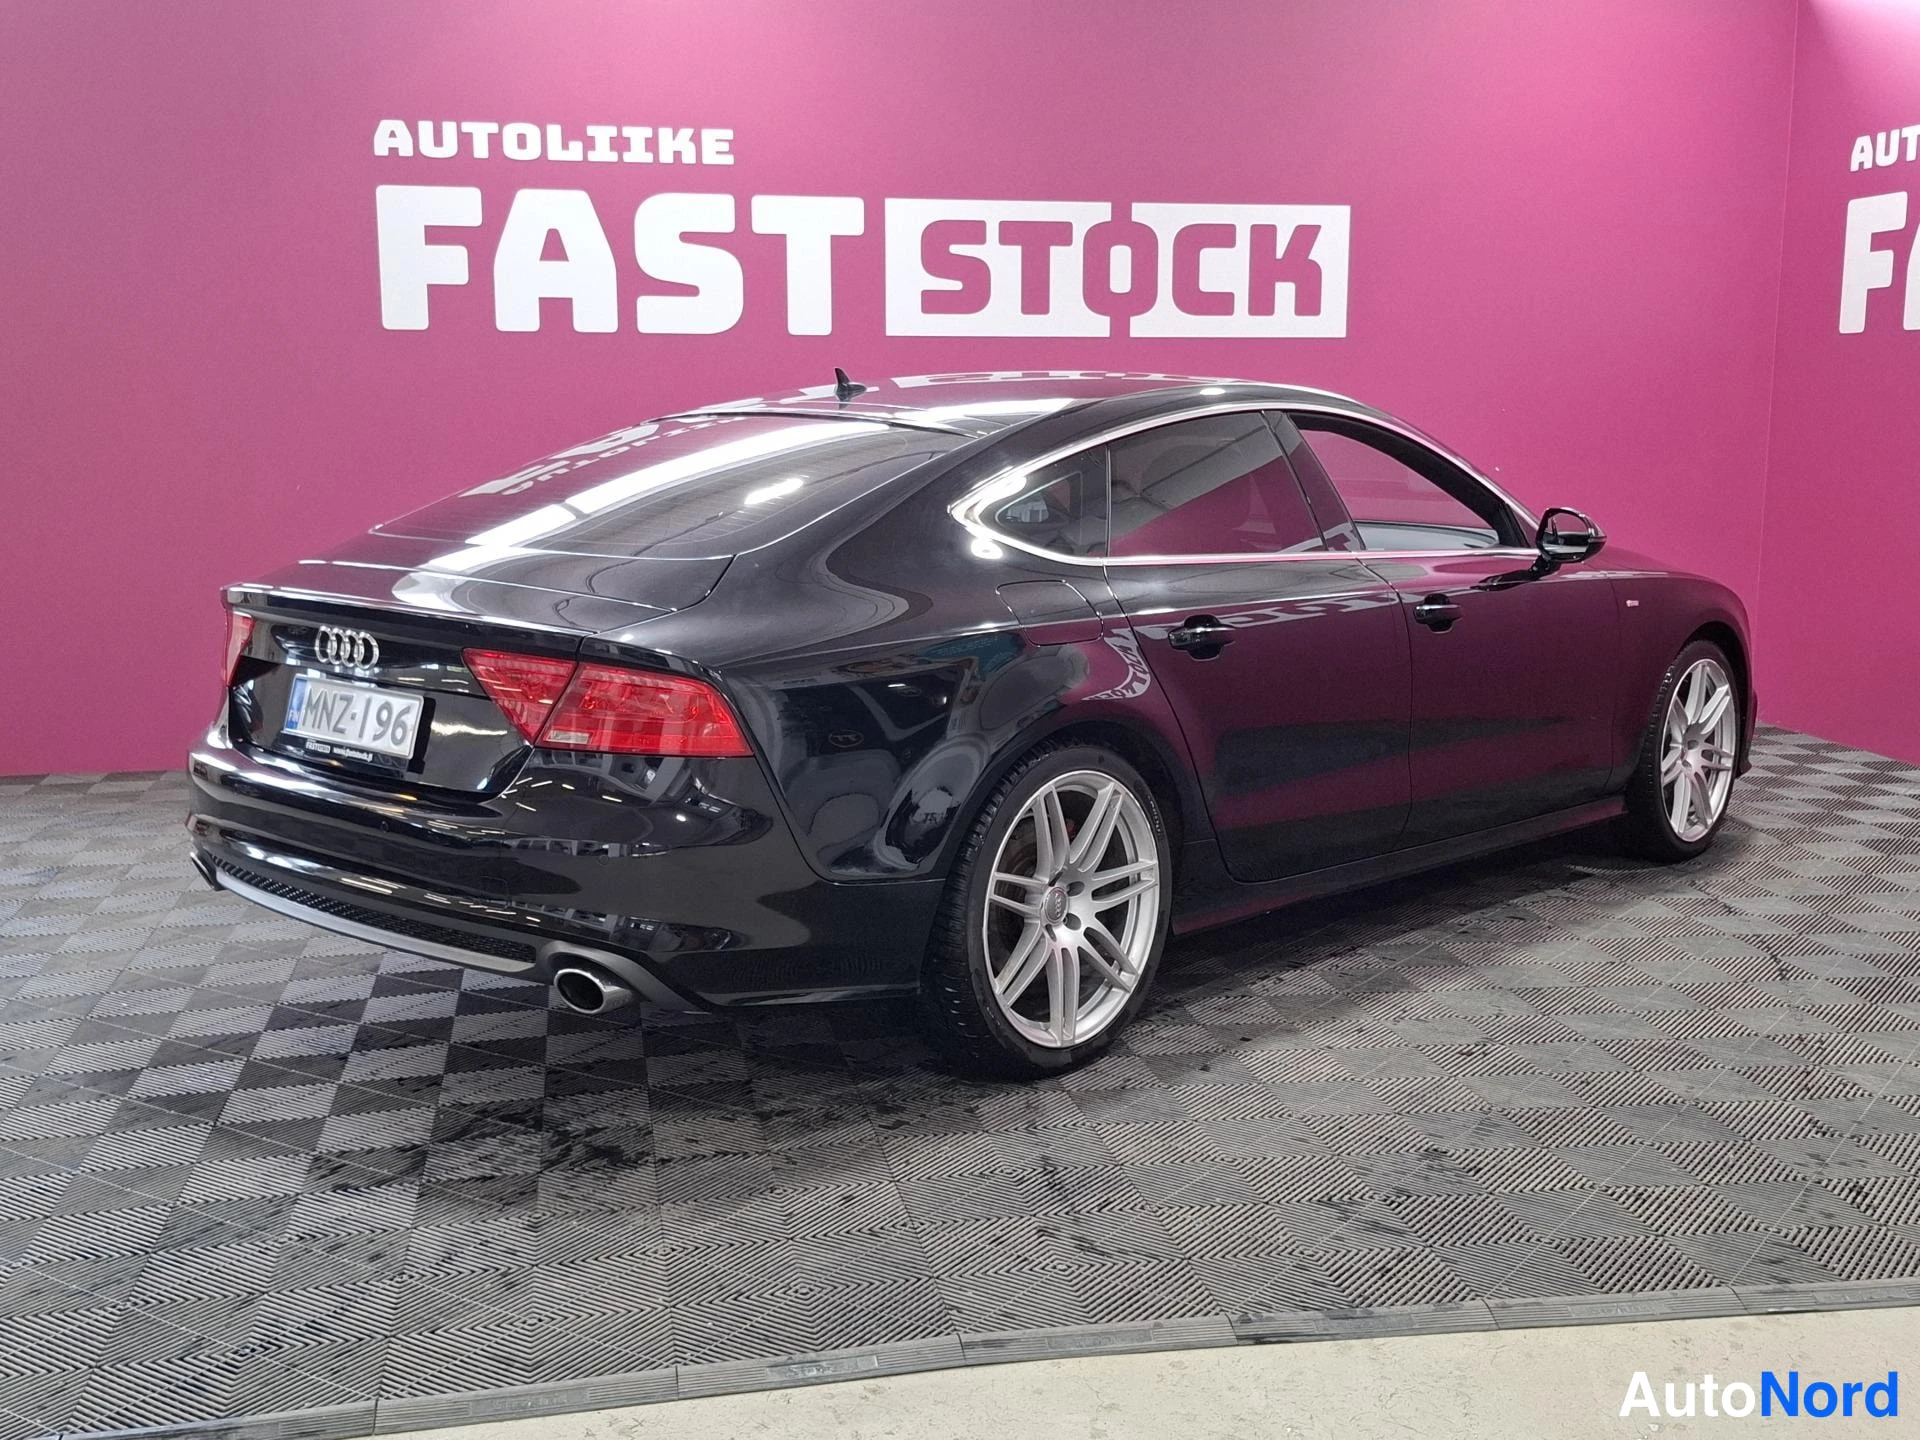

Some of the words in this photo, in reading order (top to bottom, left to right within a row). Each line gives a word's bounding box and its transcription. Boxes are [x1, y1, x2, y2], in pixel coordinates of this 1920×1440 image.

[373, 119, 735, 166] AUTOLIIKE
[375, 185, 865, 335] FAST
[918, 216, 1325, 319] STOCK
[1838, 191, 1920, 334] F
[302, 687, 412, 746] MNZ-196
